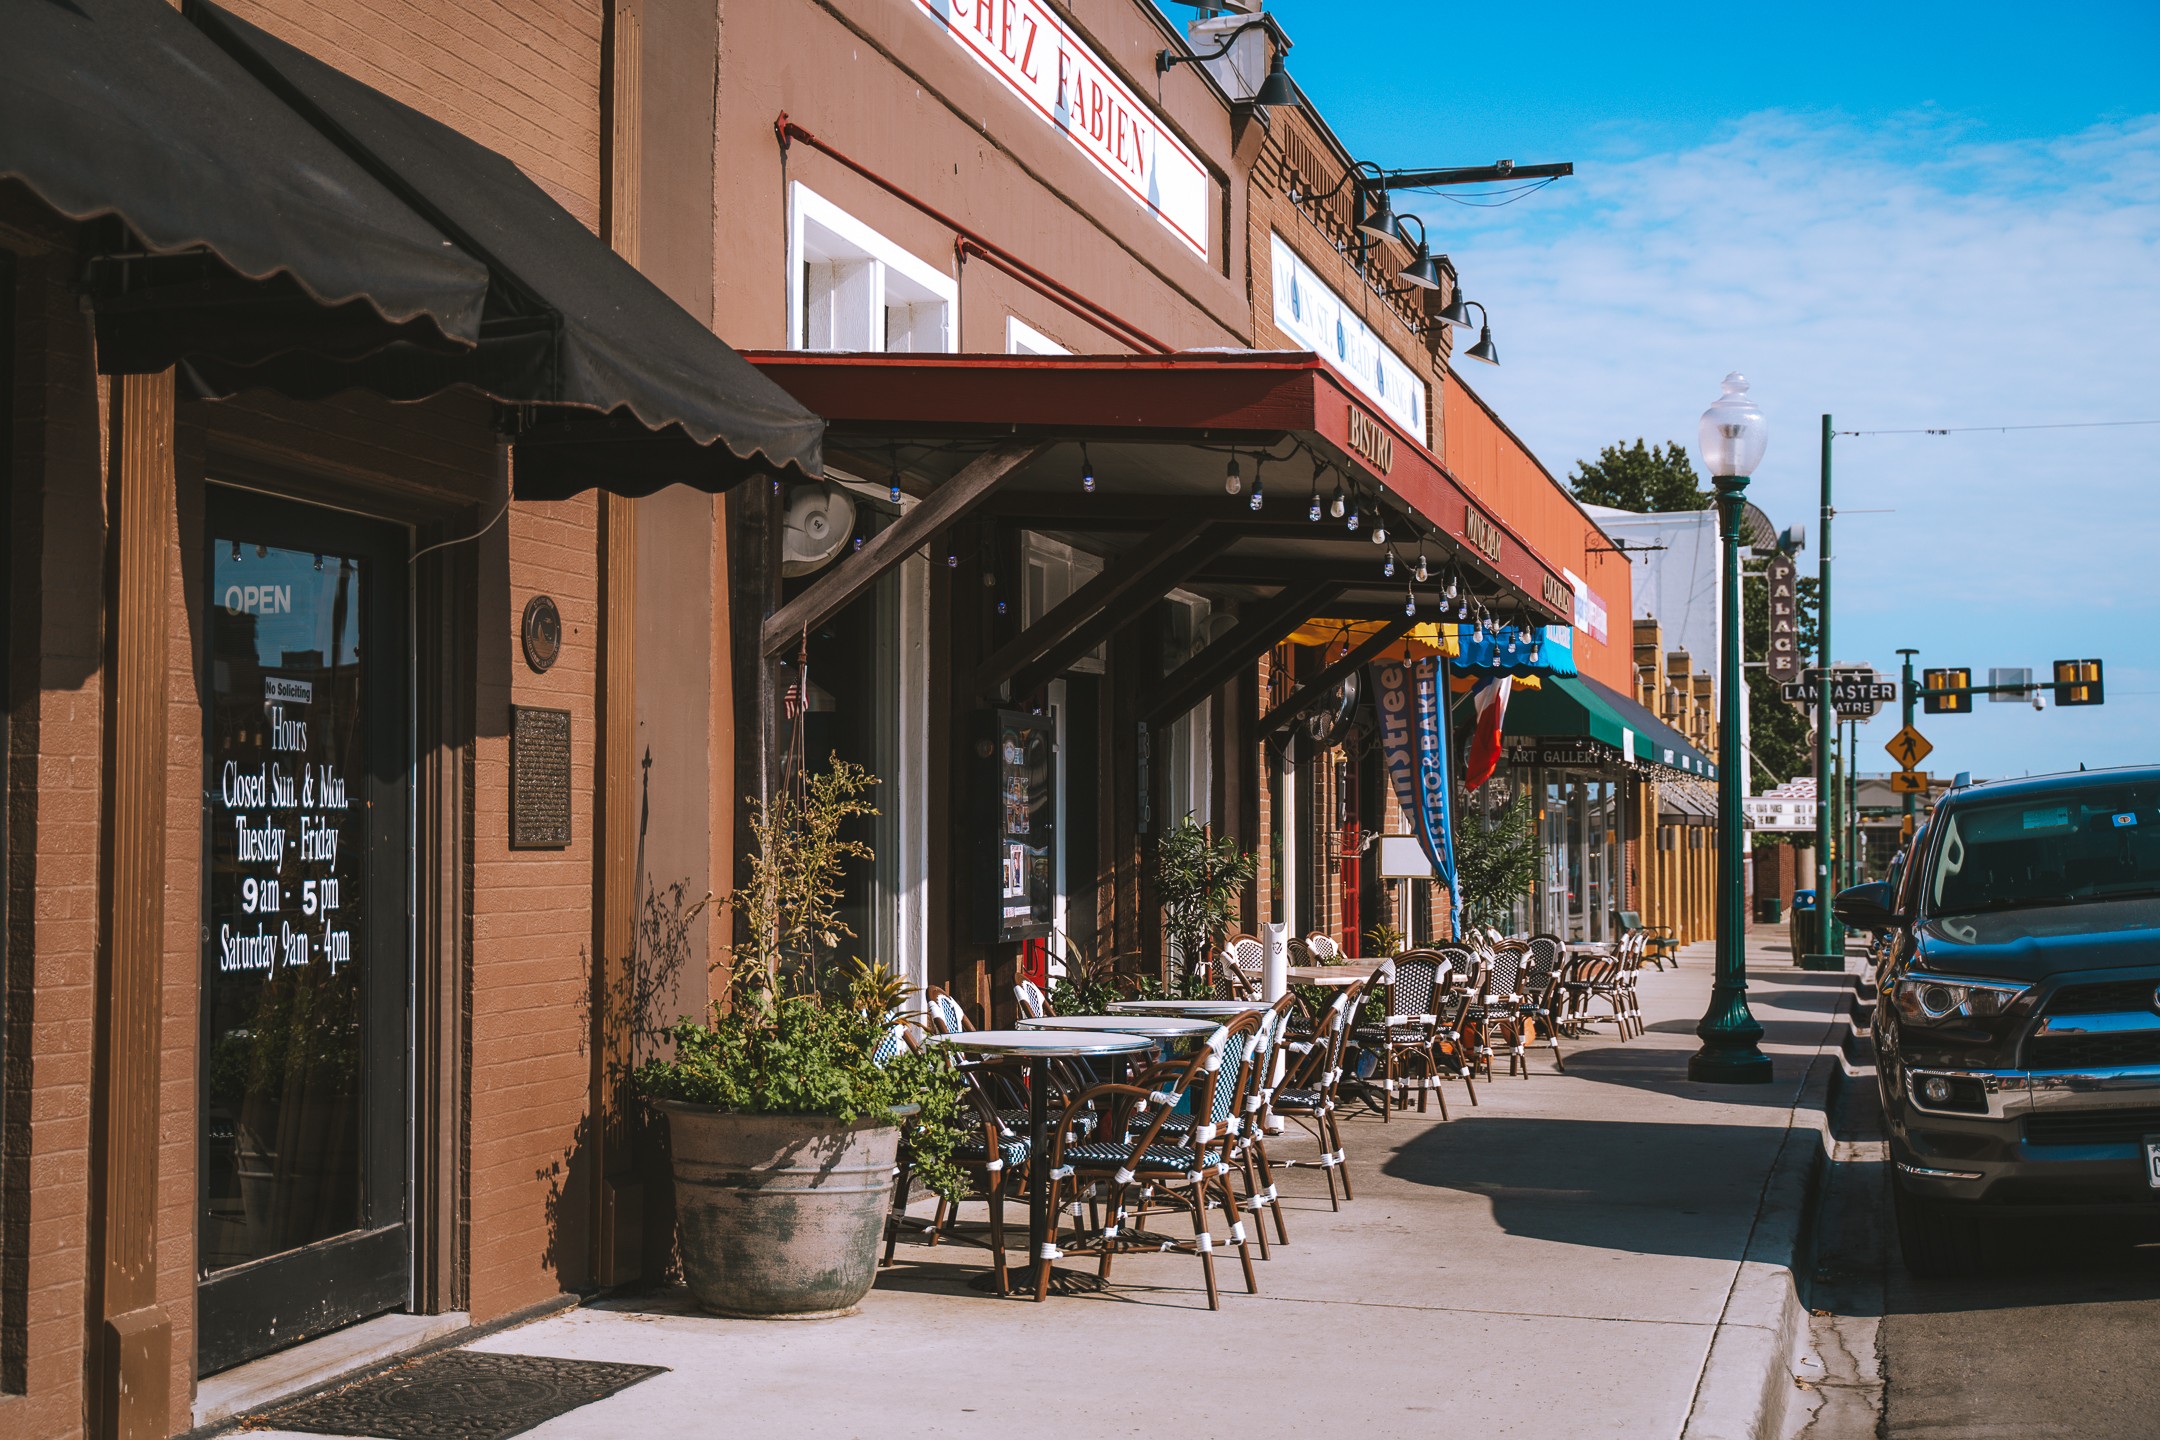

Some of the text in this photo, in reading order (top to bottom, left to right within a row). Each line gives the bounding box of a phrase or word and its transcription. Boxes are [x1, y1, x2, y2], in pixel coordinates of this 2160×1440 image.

[953, 0, 1145, 182] HEZ FABIEN
[1279, 262, 1315, 331] MAIN
[1336, 319, 1370, 381] BREAD
[1349, 404, 1393, 474] BISTRO
[1467, 505, 1502, 563] WINE BAR
[225, 584, 292, 616] OPEN
[1543, 573, 1570, 615] COCKTAILS
[1774, 566, 1792, 670] PALACE
[265, 681, 311, 702] No Soliciting
[1785, 683, 1893, 699] LANASTER
[1806, 702, 1872, 713] TATRE
[271, 706, 307, 752] Hours
[1511, 750, 1538, 764] ART
[222, 760, 349, 809] Closed Sun. & Mon.
[235, 815, 286, 875] Tuesday
[300, 815, 339, 873] Friday
[220, 921, 278, 981] Saturday
[281, 920, 309, 968] 9am
[323, 918, 351, 976] 4pm
